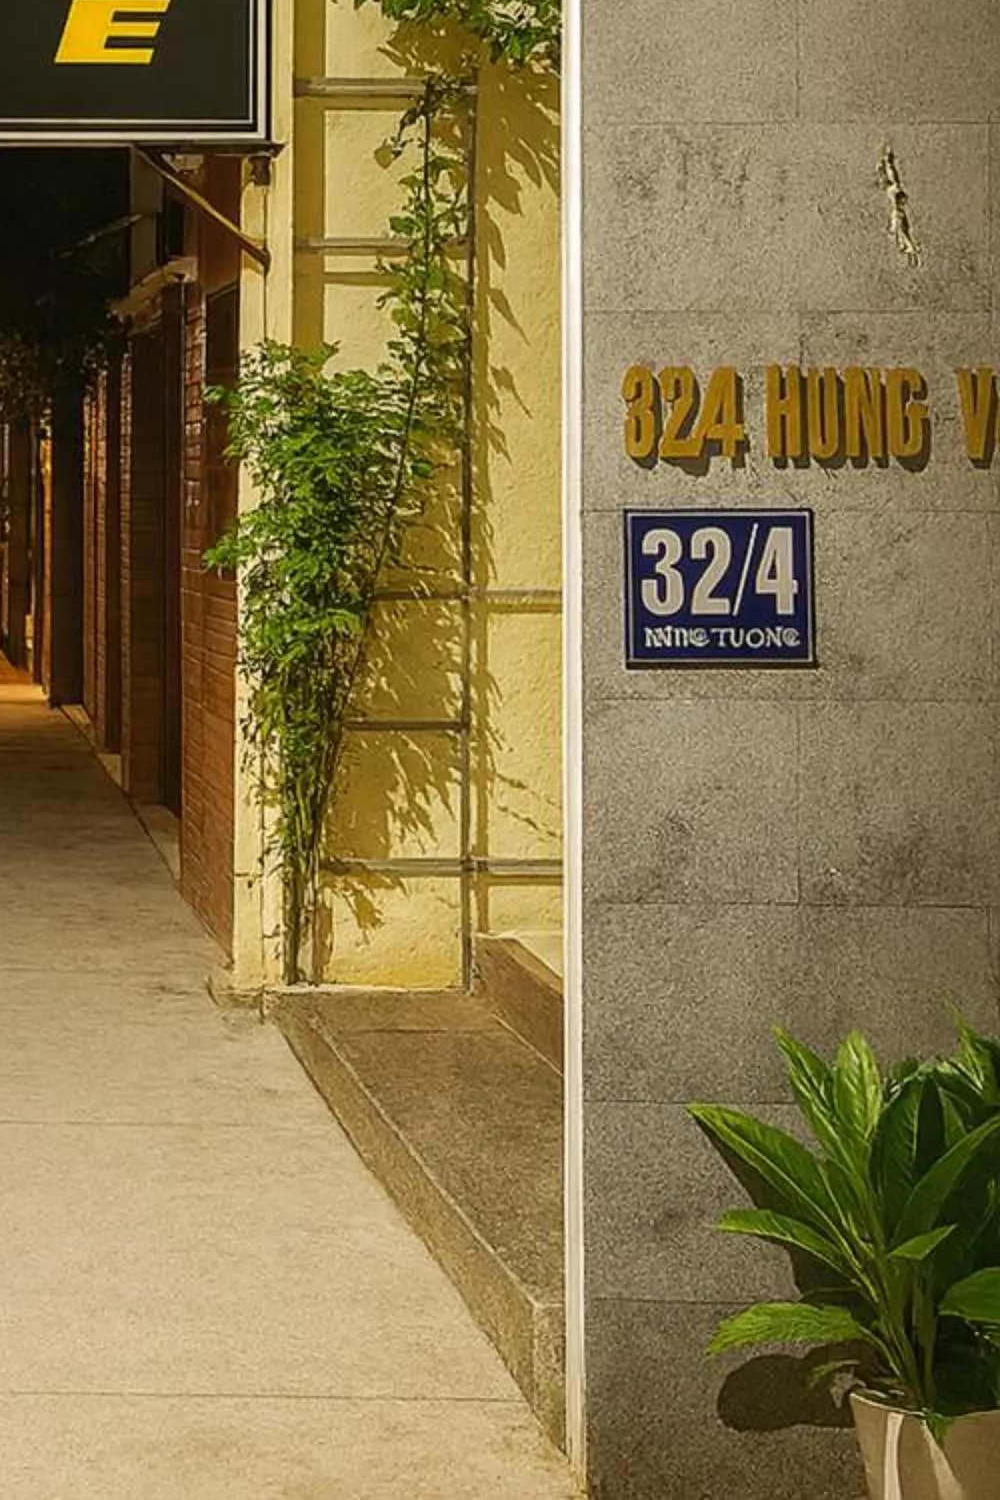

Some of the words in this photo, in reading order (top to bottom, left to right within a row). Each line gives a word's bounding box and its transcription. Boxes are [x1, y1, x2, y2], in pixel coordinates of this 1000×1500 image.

[620, 364, 750, 460] 324
[764, 364, 930, 460] HUNG
[954, 368, 1000, 460] V
[640, 522, 798, 617] 32/4
